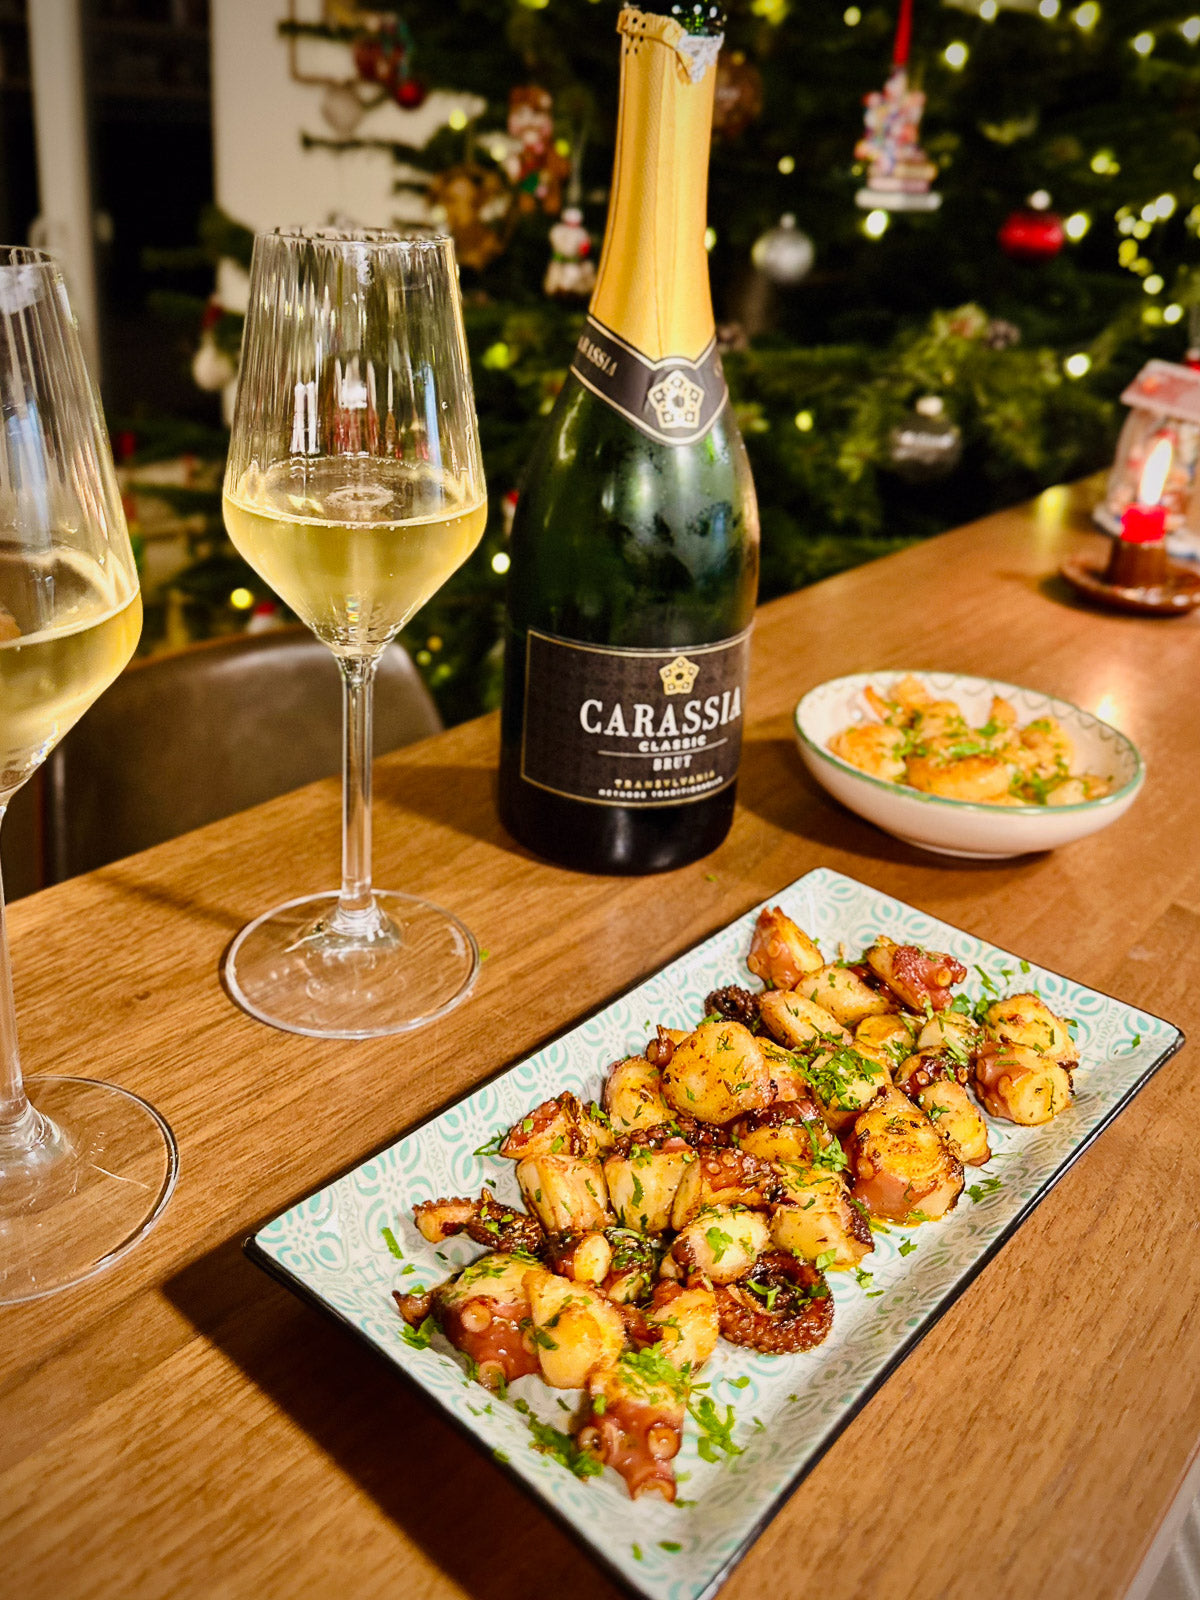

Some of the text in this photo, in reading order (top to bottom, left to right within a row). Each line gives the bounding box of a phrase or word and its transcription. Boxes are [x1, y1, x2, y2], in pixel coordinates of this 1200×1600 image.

[580, 686, 742, 738] CARASSIA
[638, 734, 707, 753] CLASSIC
[653, 754, 692, 772] BRUT
